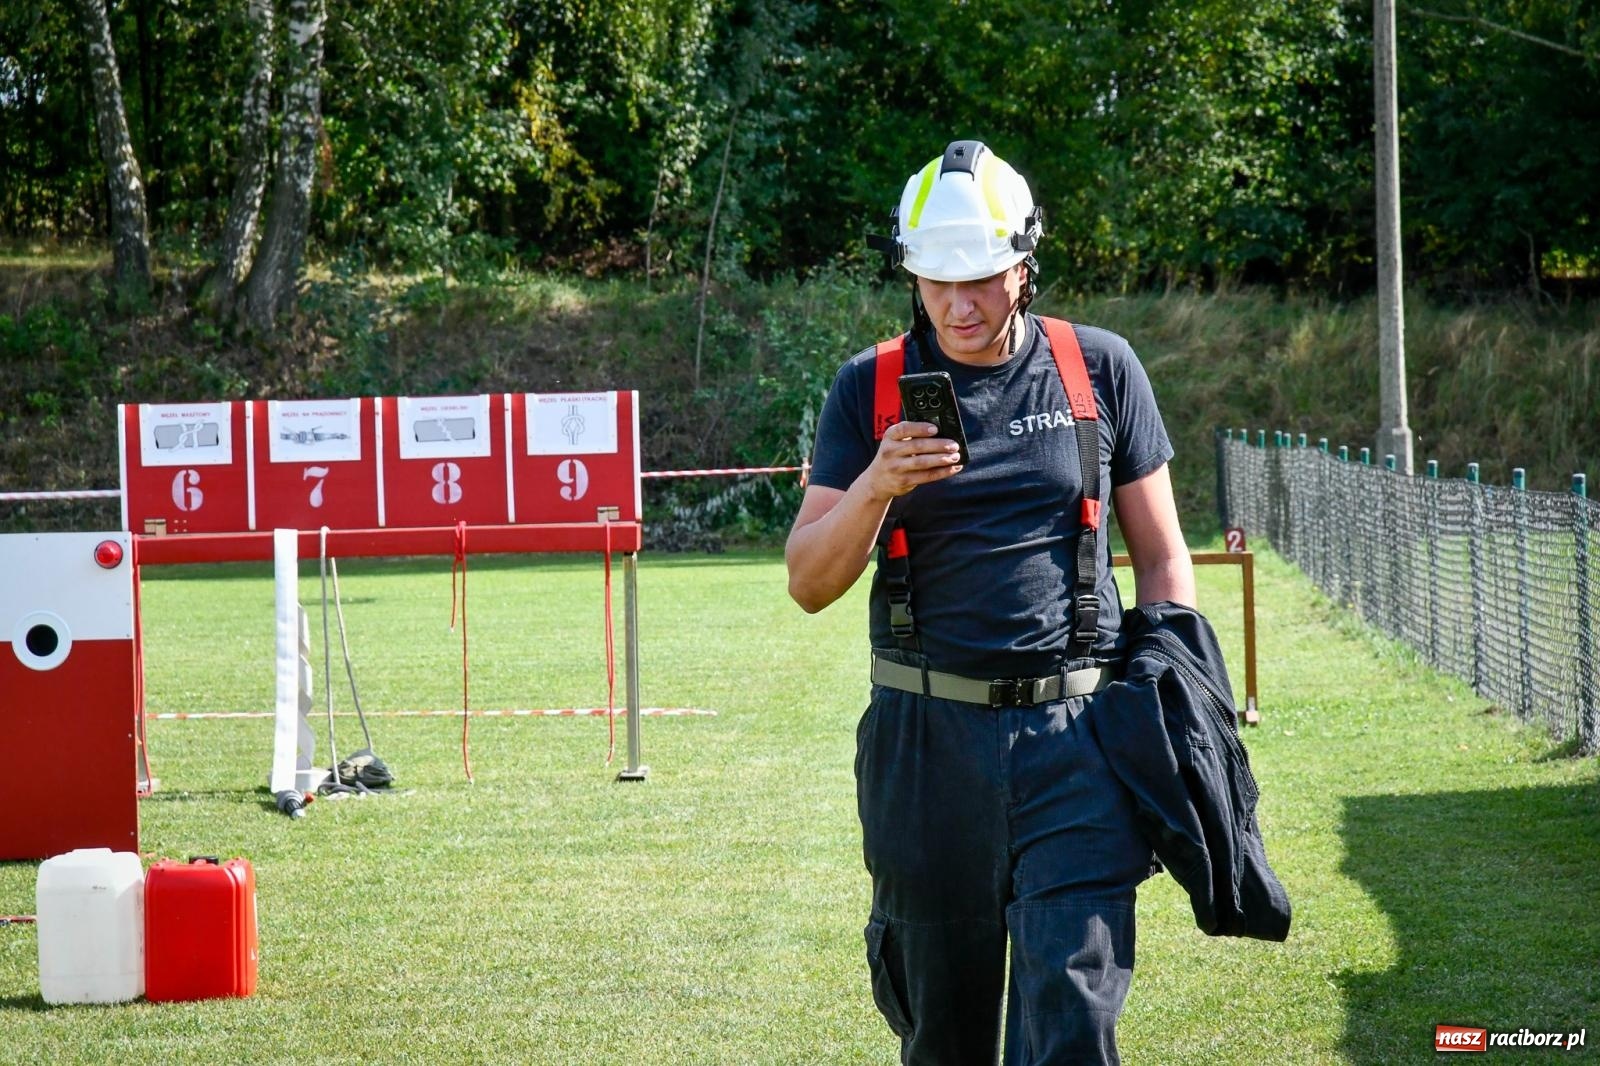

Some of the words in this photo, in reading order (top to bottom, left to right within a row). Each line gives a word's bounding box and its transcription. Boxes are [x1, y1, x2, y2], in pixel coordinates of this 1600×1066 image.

[172, 469, 203, 512] 6
[303, 466, 330, 508] 7
[431, 462, 462, 505] 8
[556, 459, 589, 501] 9
[1227, 530, 1243, 553] 2
